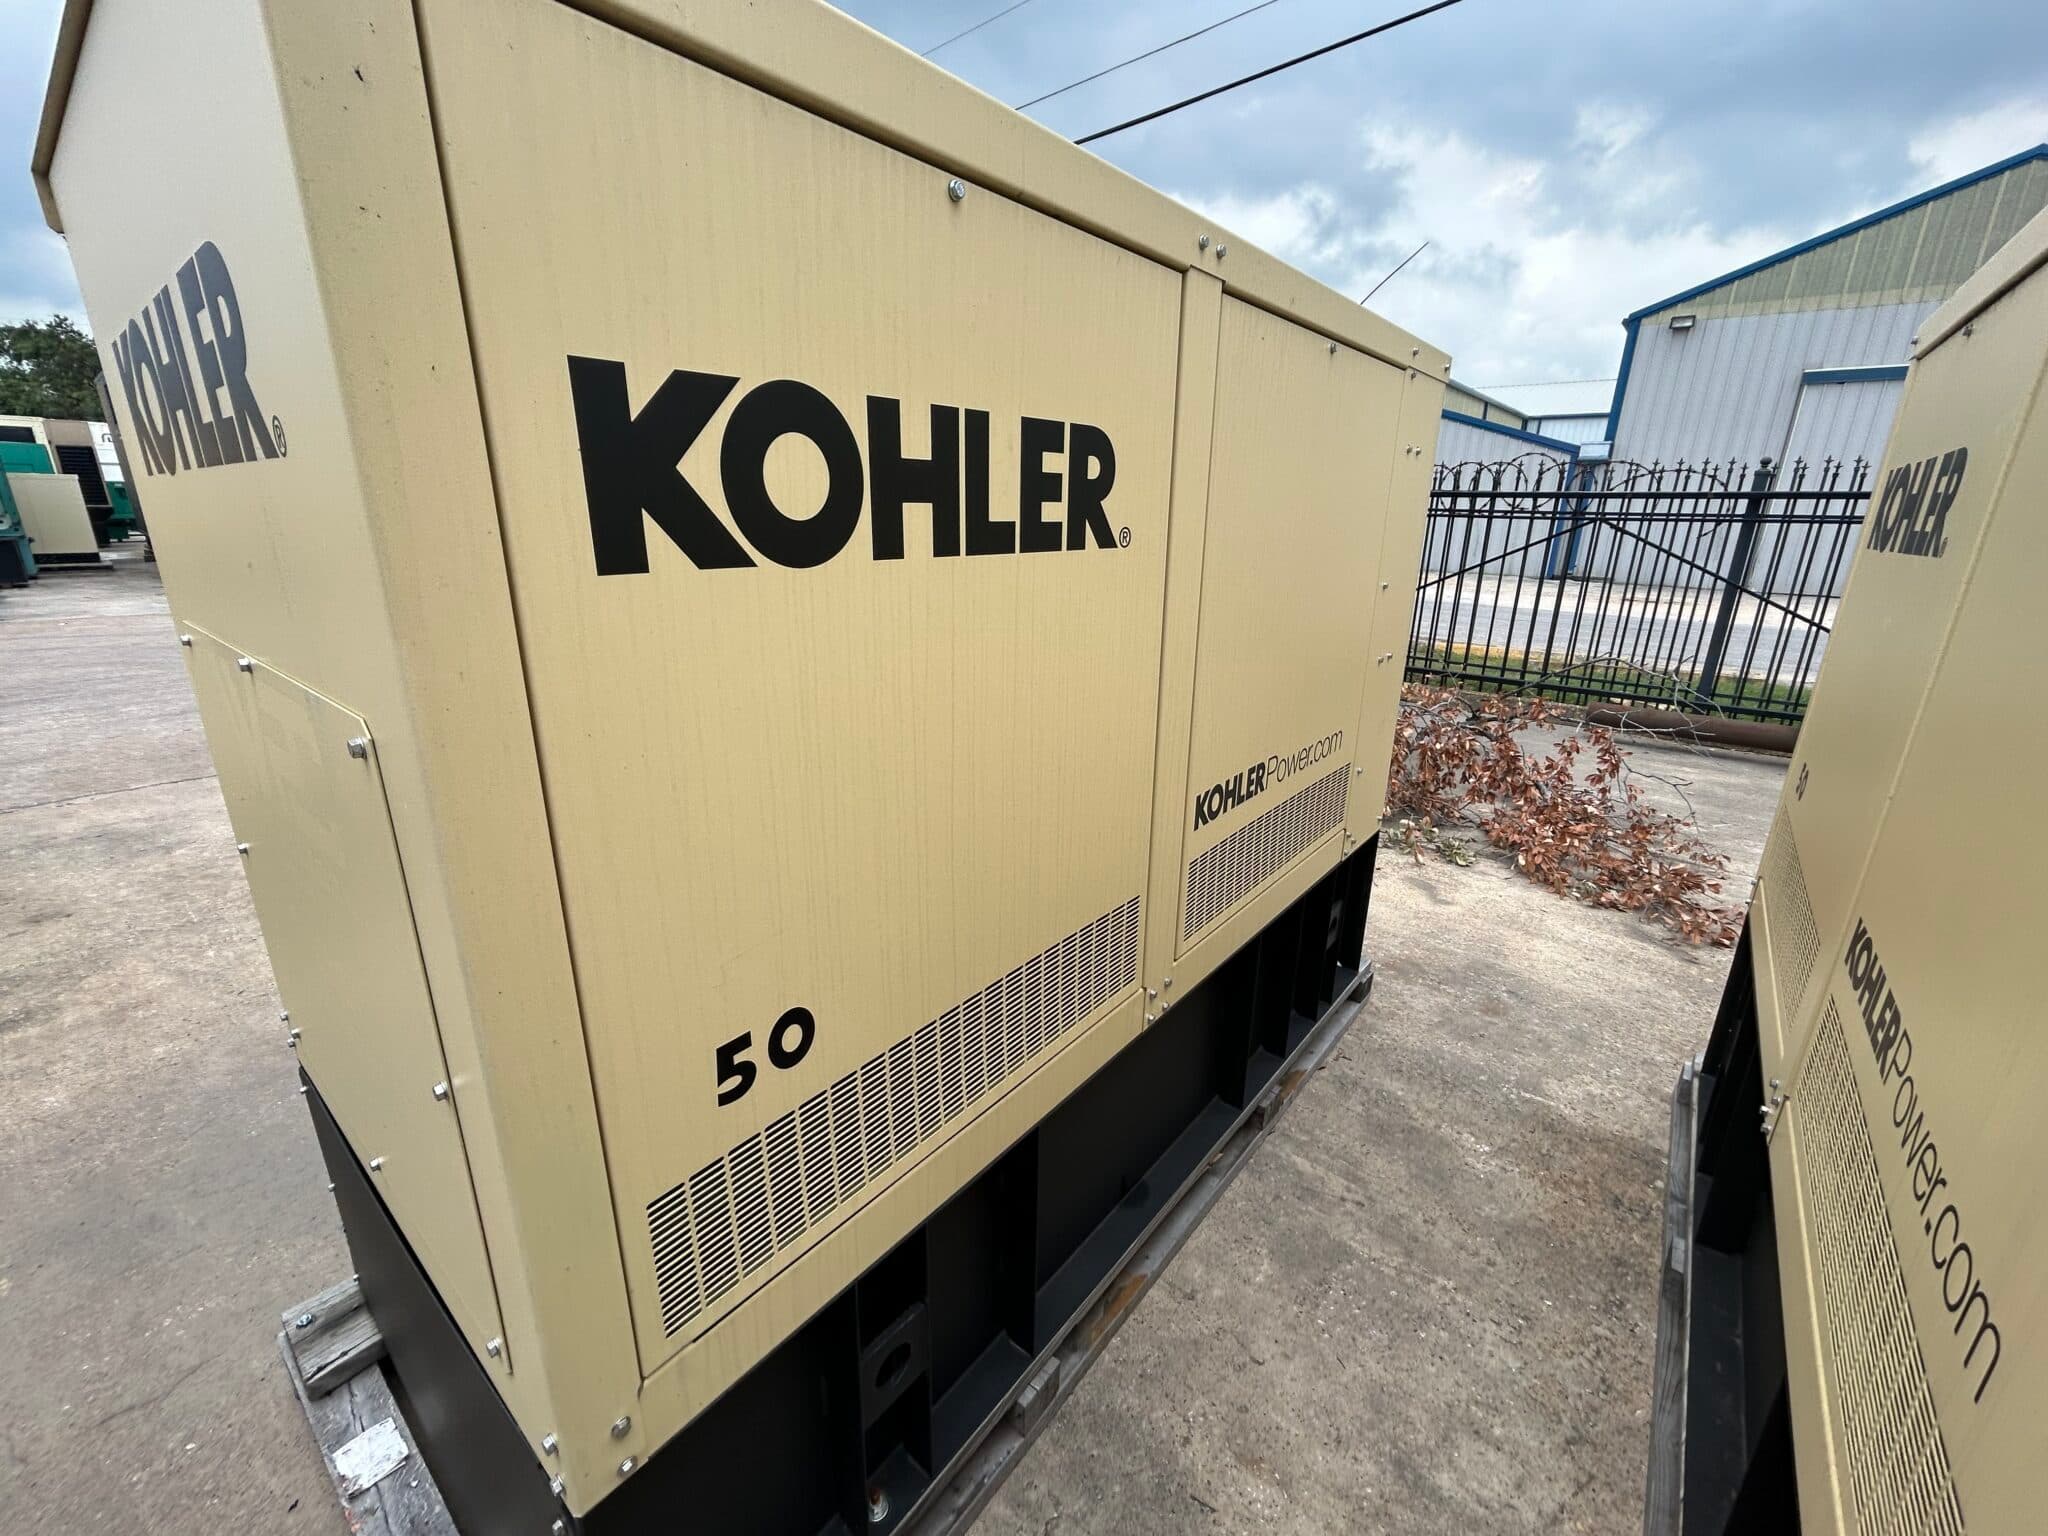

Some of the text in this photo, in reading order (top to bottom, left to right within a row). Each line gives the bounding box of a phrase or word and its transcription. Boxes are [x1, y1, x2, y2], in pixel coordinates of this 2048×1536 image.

[112, 241, 279, 476] KOHLER
[567, 354, 1118, 576] KOHLER
[1867, 447, 1968, 558] KOHLER
[1194, 730, 1343, 831] KOHLERPower.com
[716, 1007, 815, 1107] 50
